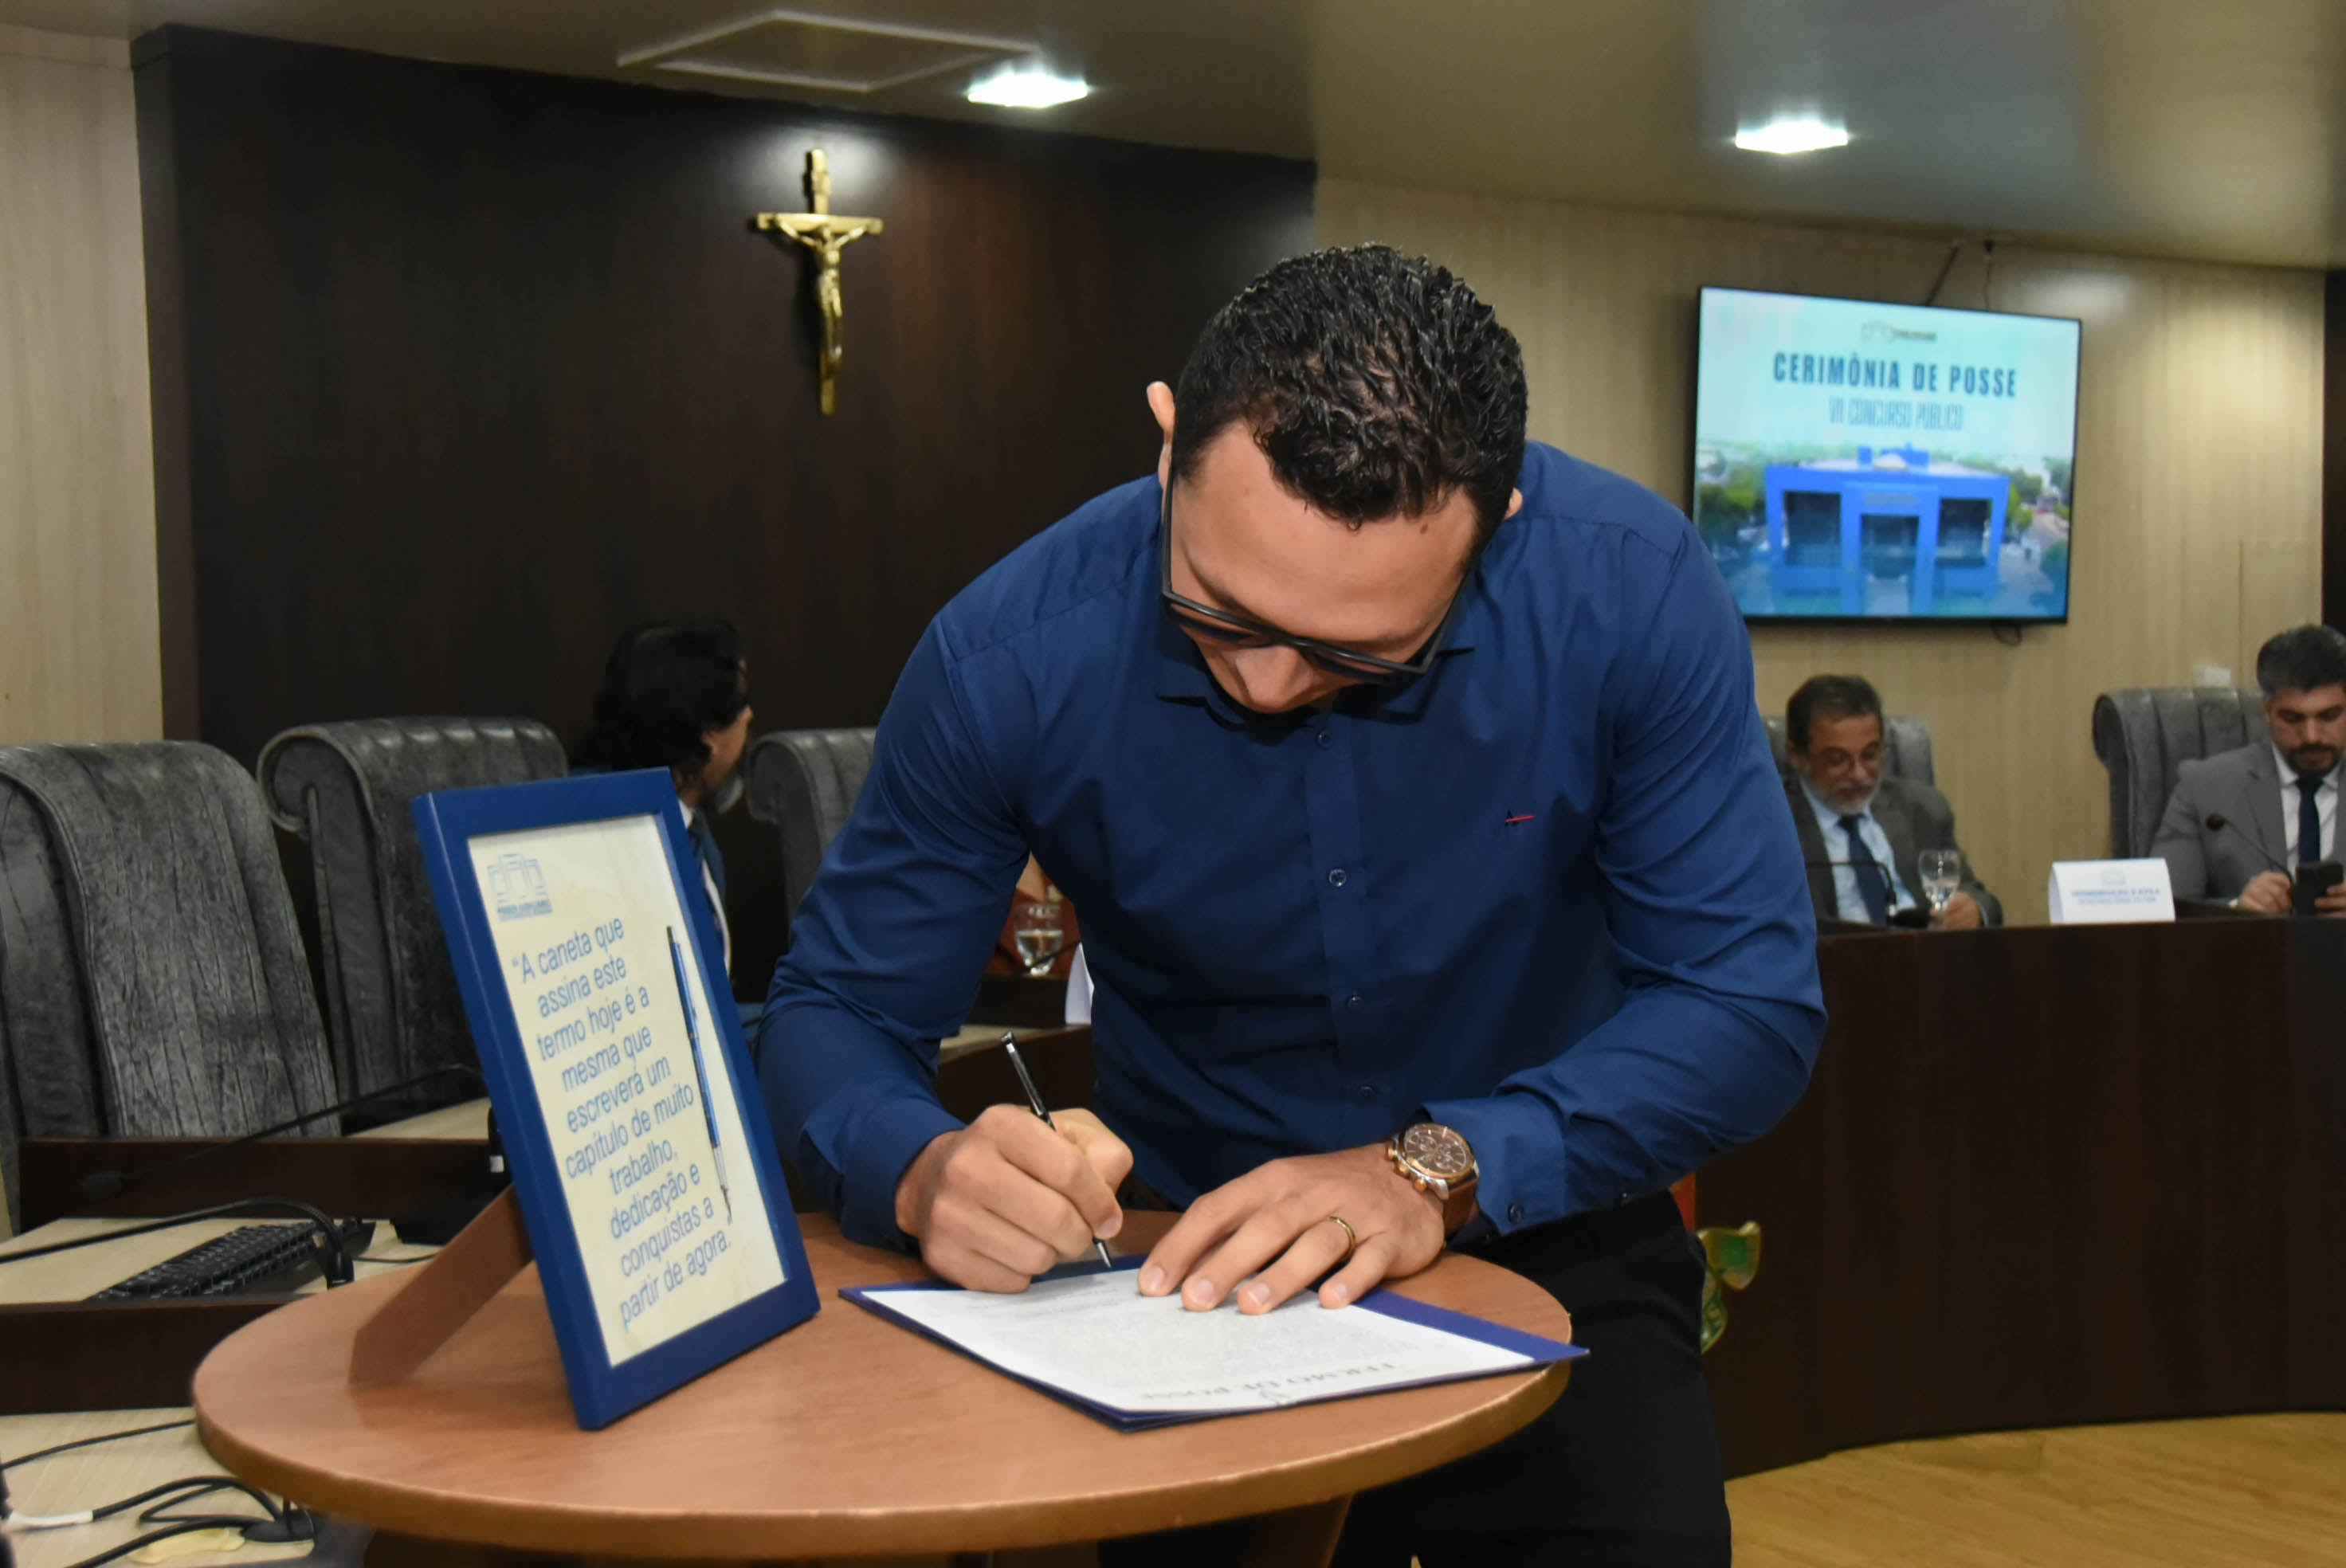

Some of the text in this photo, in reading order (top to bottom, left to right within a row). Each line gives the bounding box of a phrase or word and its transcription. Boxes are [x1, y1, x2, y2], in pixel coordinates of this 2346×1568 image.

[1774, 351, 2016, 397] CERIMÔNIA DE POSSE
[538, 930, 592, 976] caneta
[595, 917, 625, 953] que
[537, 956, 627, 1018] assina este
[536, 985, 650, 1062] termo hoje é a
[561, 1025, 652, 1093] mesma que
[645, 1056, 672, 1088] um
[565, 1082, 695, 1180] capítulo de muito
[610, 1162, 702, 1241] dedicação e
[620, 1196, 715, 1278] conquistas a
[618, 1276, 661, 1333] partir
[663, 1261, 684, 1293] de
